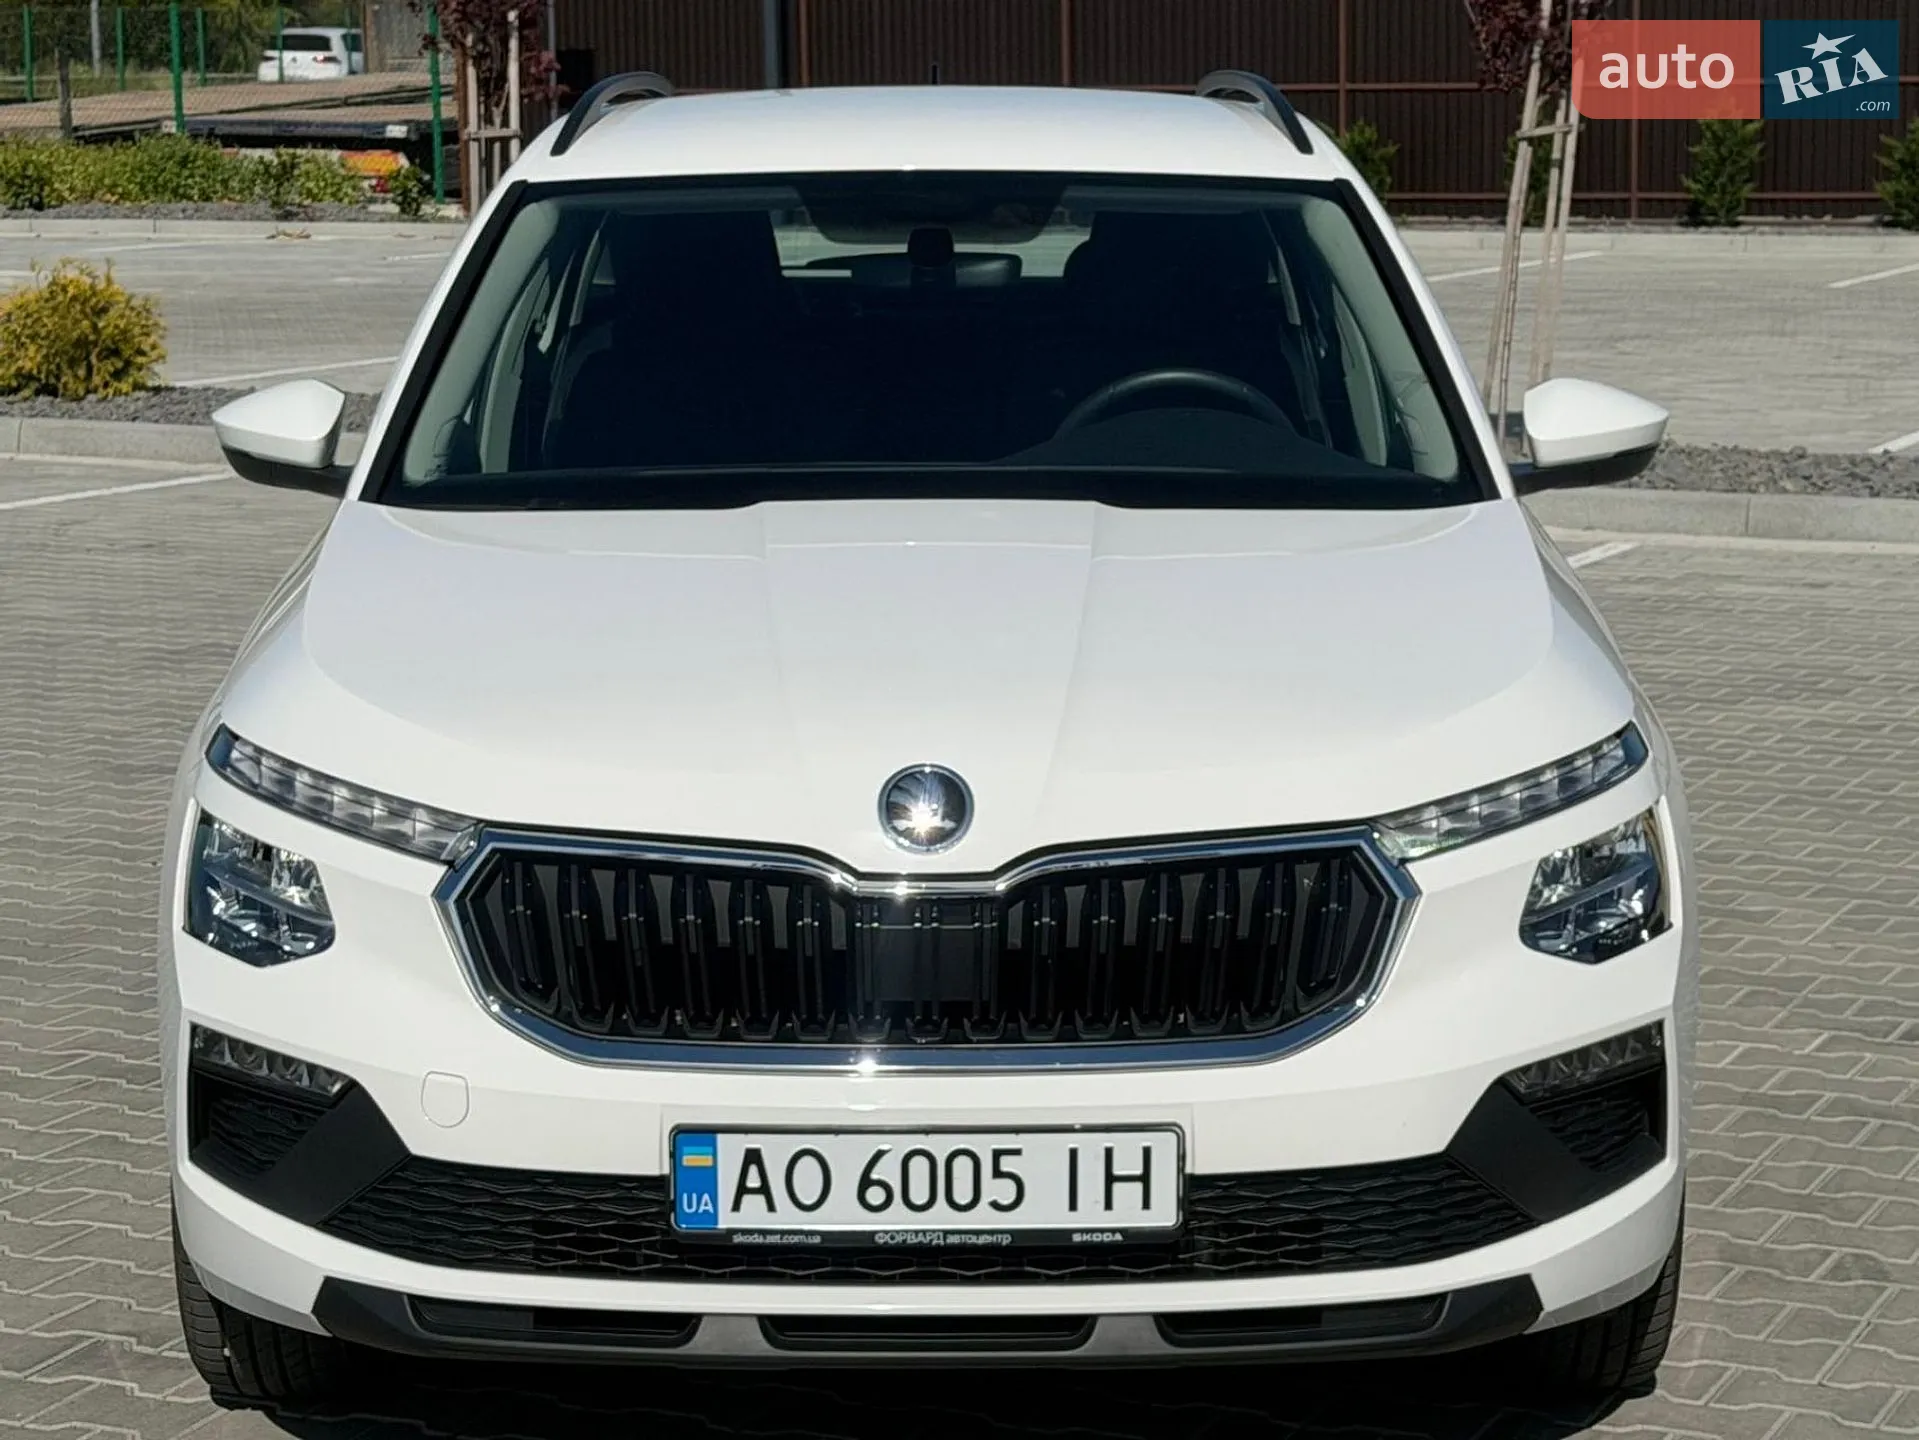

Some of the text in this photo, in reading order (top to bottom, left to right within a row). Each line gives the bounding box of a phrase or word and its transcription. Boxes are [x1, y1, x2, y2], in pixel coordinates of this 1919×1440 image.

[731, 1144, 1152, 1213] AO 6005 IH
[683, 1192, 714, 1214] UA
[874, 1231, 1012, 1246] ФОРВАРД автоцентр
[1071, 1231, 1124, 1243] SKODA
